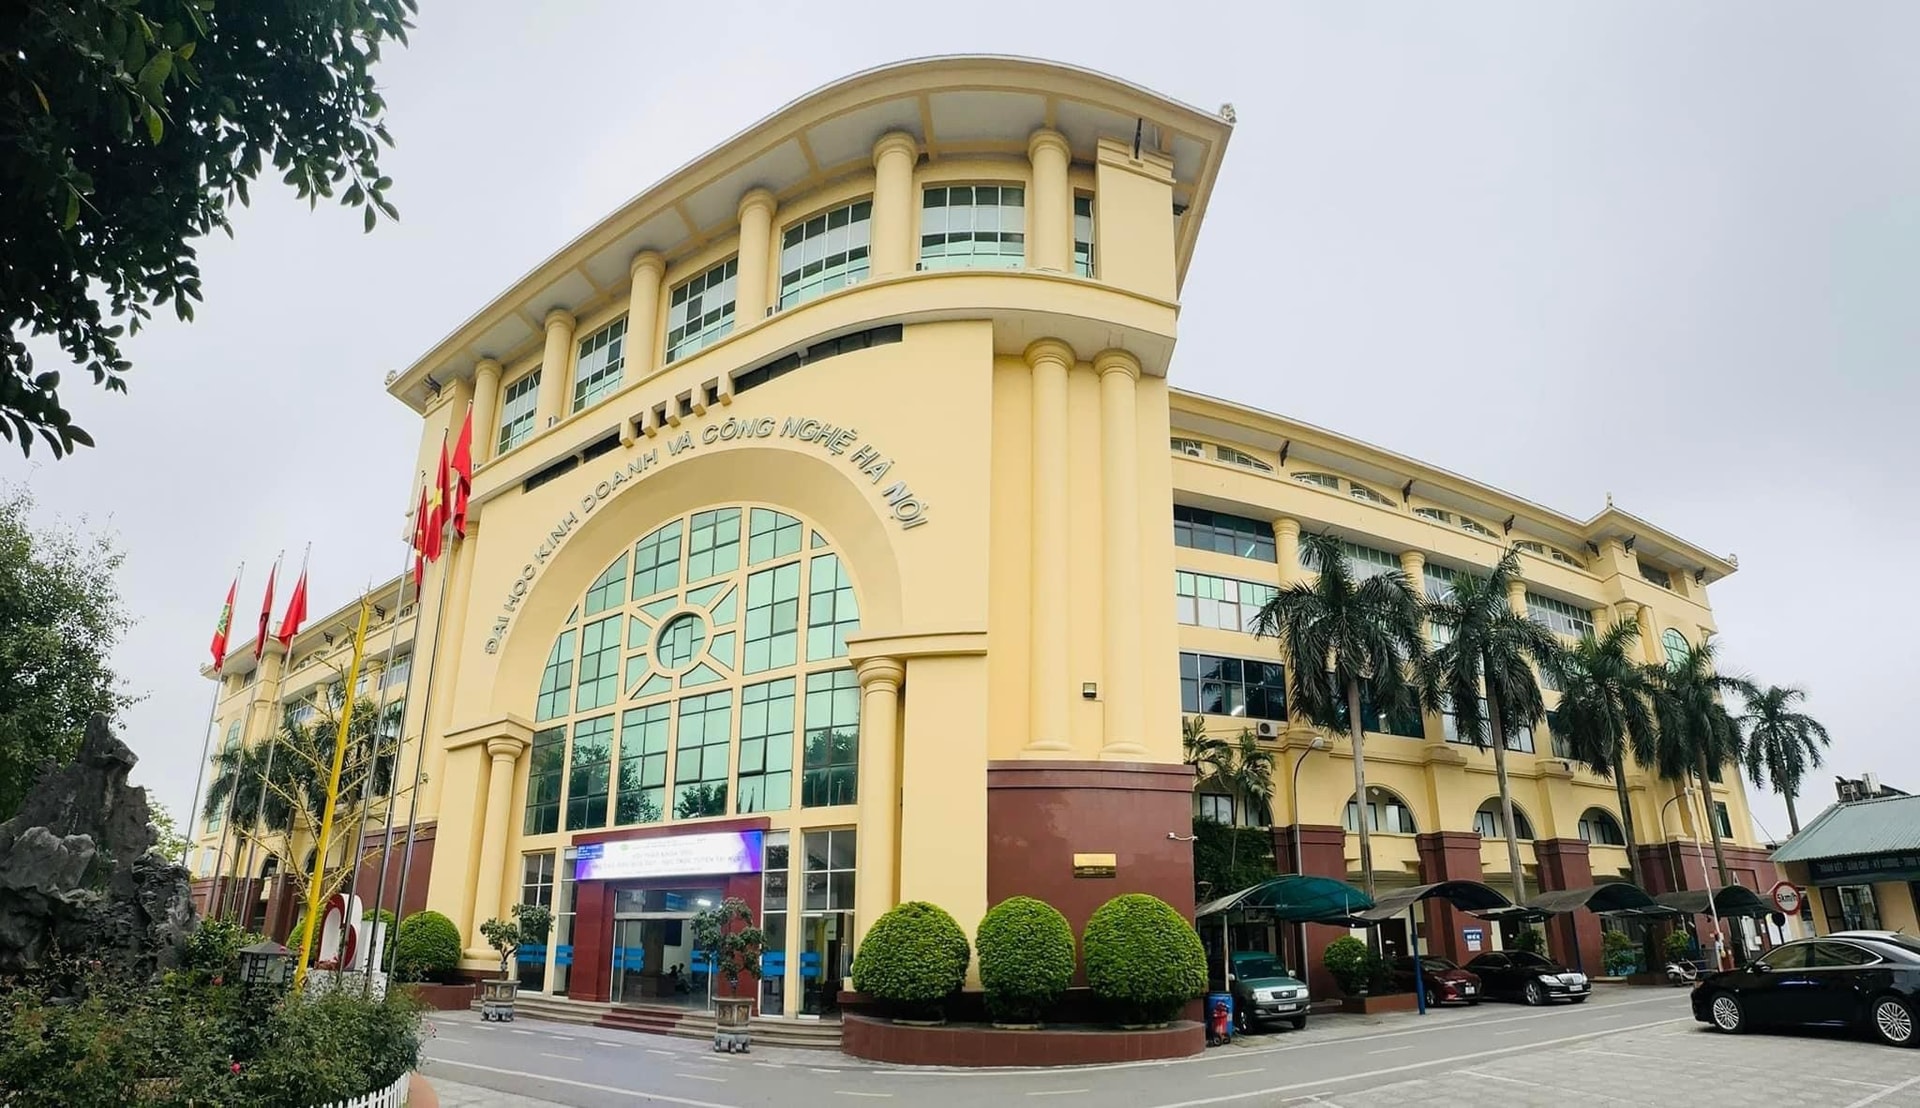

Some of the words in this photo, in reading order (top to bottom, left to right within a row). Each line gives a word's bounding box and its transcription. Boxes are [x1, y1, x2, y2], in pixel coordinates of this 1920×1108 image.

[504, 564, 536, 612] HỌC
[535, 512, 578, 564] KINH
[581, 448, 658, 513] DOANH
[667, 431, 695, 456] VÀ
[702, 416, 776, 444] CÔNG
[780, 416, 857, 456] NGHỆ
[850, 443, 895, 485] HÀ
[882, 479, 929, 531] NỘI
